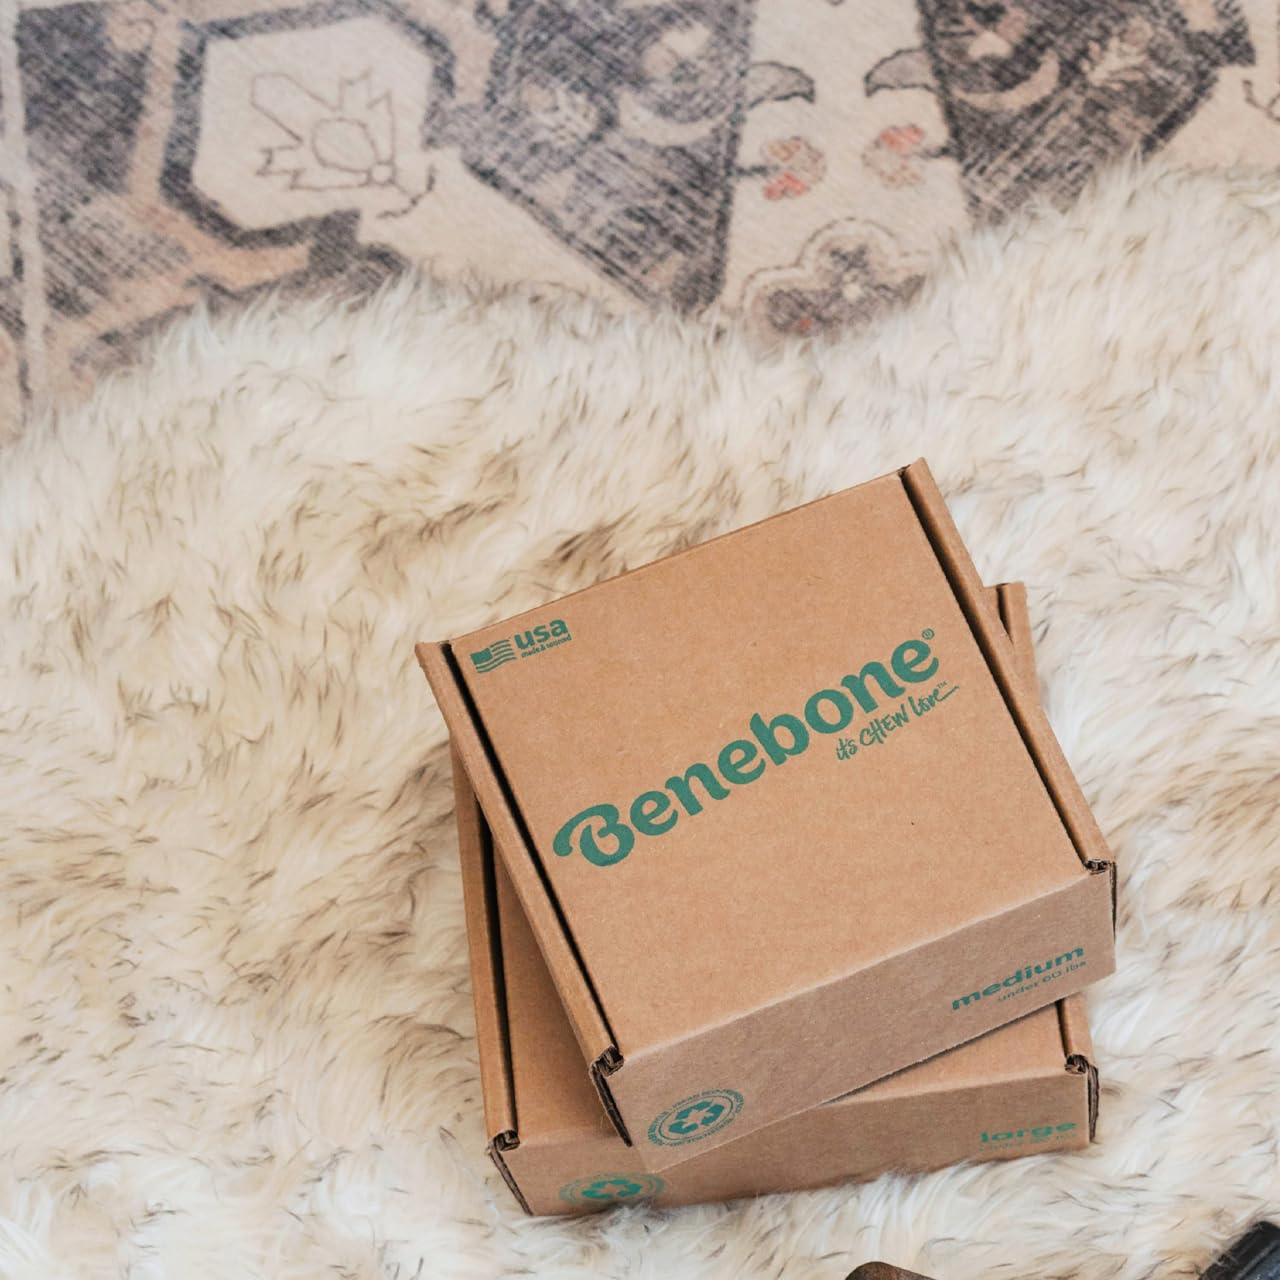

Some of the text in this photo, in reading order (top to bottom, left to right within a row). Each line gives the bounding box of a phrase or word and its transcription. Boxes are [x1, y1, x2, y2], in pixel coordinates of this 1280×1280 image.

[514, 618, 568, 650] usa
[952, 947, 1084, 1010] medium
[980, 1122, 1078, 1143] large
